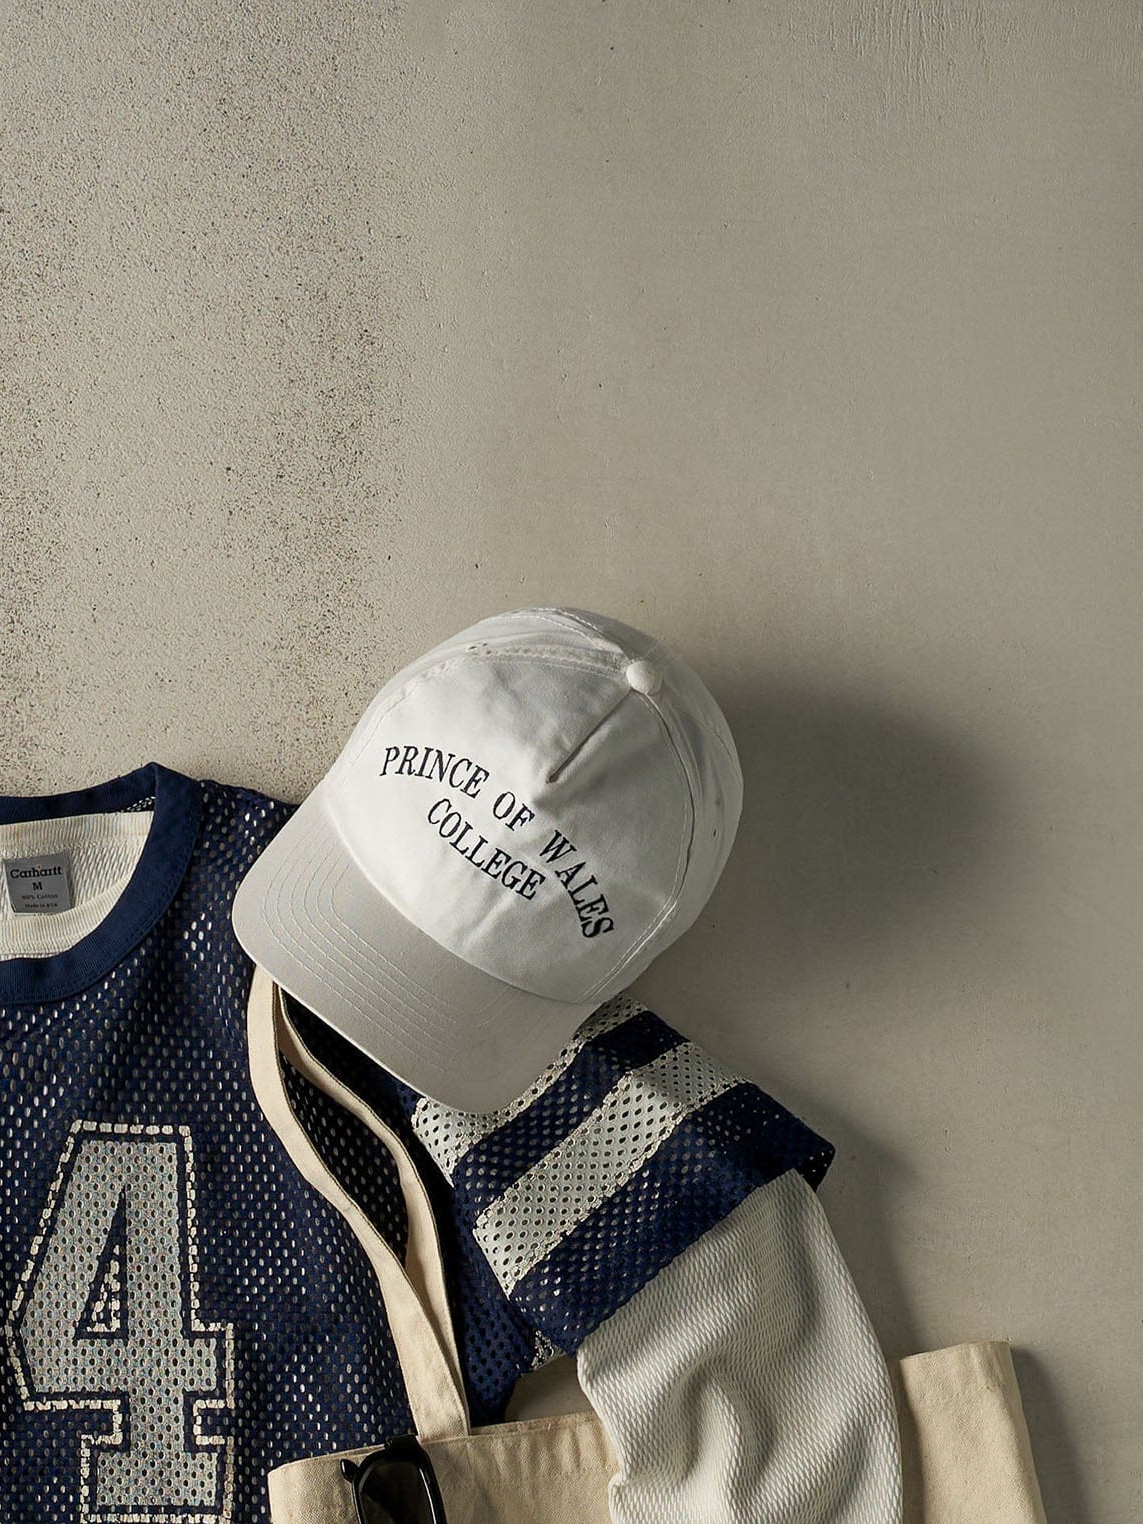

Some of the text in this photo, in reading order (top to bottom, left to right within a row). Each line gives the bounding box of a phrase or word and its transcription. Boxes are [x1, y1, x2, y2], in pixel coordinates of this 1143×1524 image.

[32, 881, 43, 891] M
[379, 745, 615, 938] PRINCE OF WALES
[427, 798, 546, 901] COLLEGE
